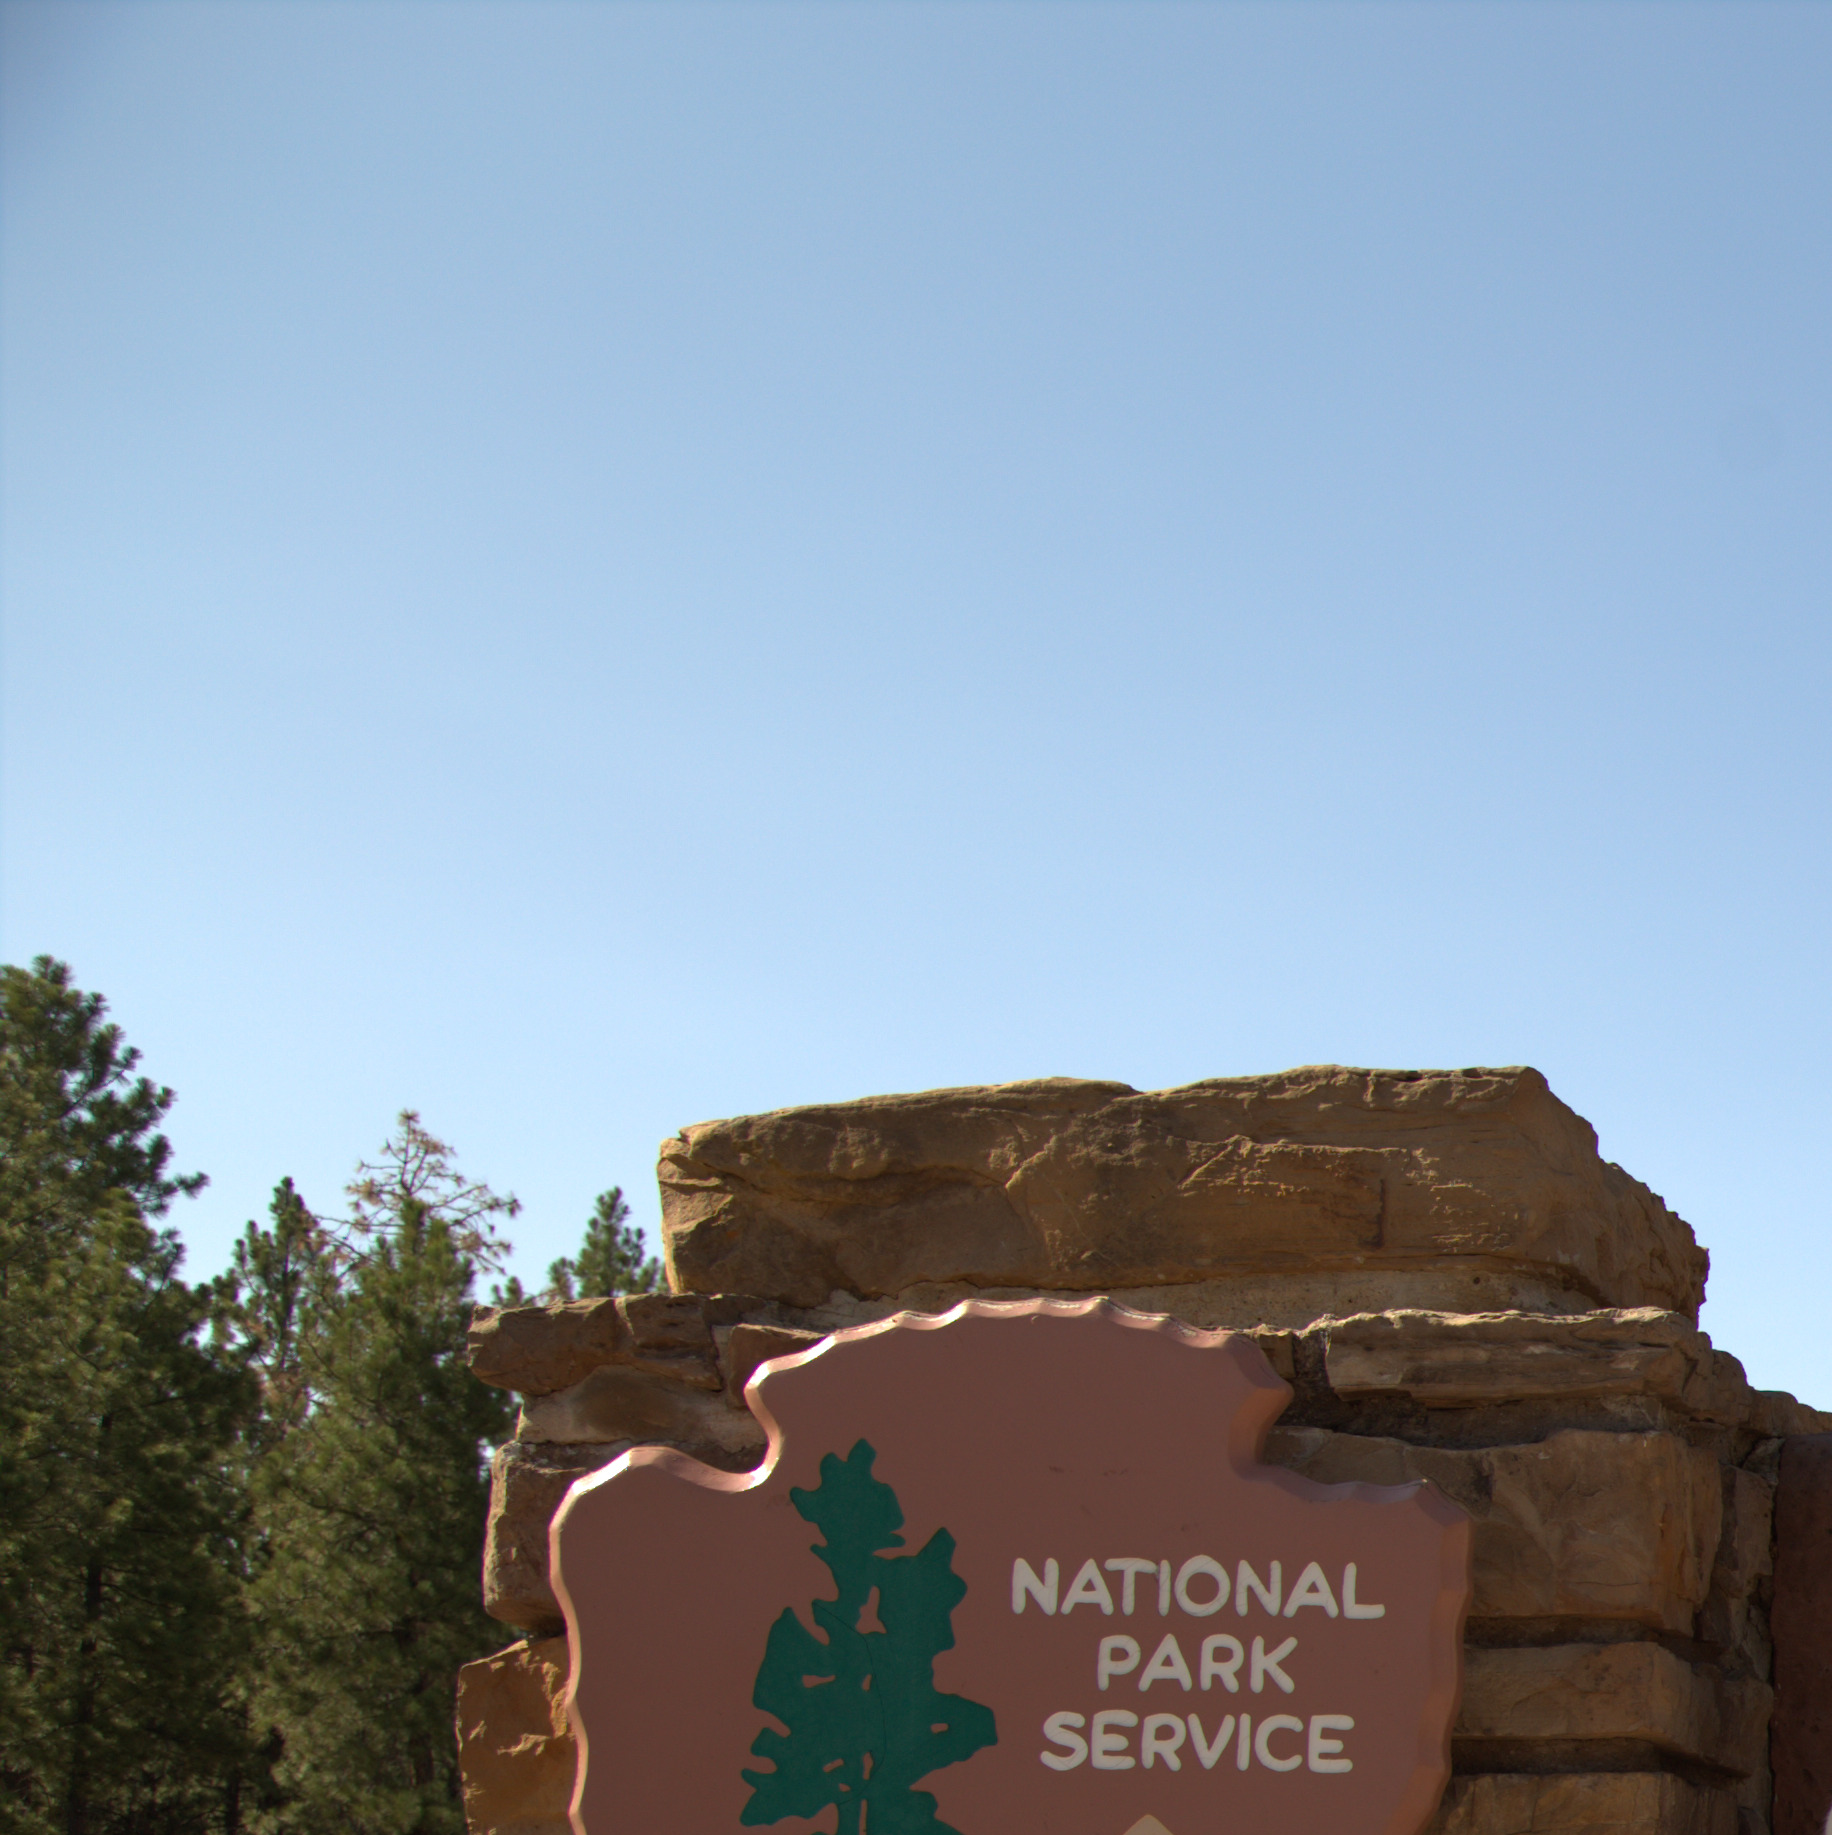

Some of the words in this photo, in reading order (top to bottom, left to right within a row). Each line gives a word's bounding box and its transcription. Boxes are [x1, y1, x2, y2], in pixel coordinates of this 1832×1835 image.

[1013, 1555, 1385, 1619] NATIONAL
[1098, 1634, 1298, 1693] PARK
[1041, 1710, 1354, 1773] SERVICE
